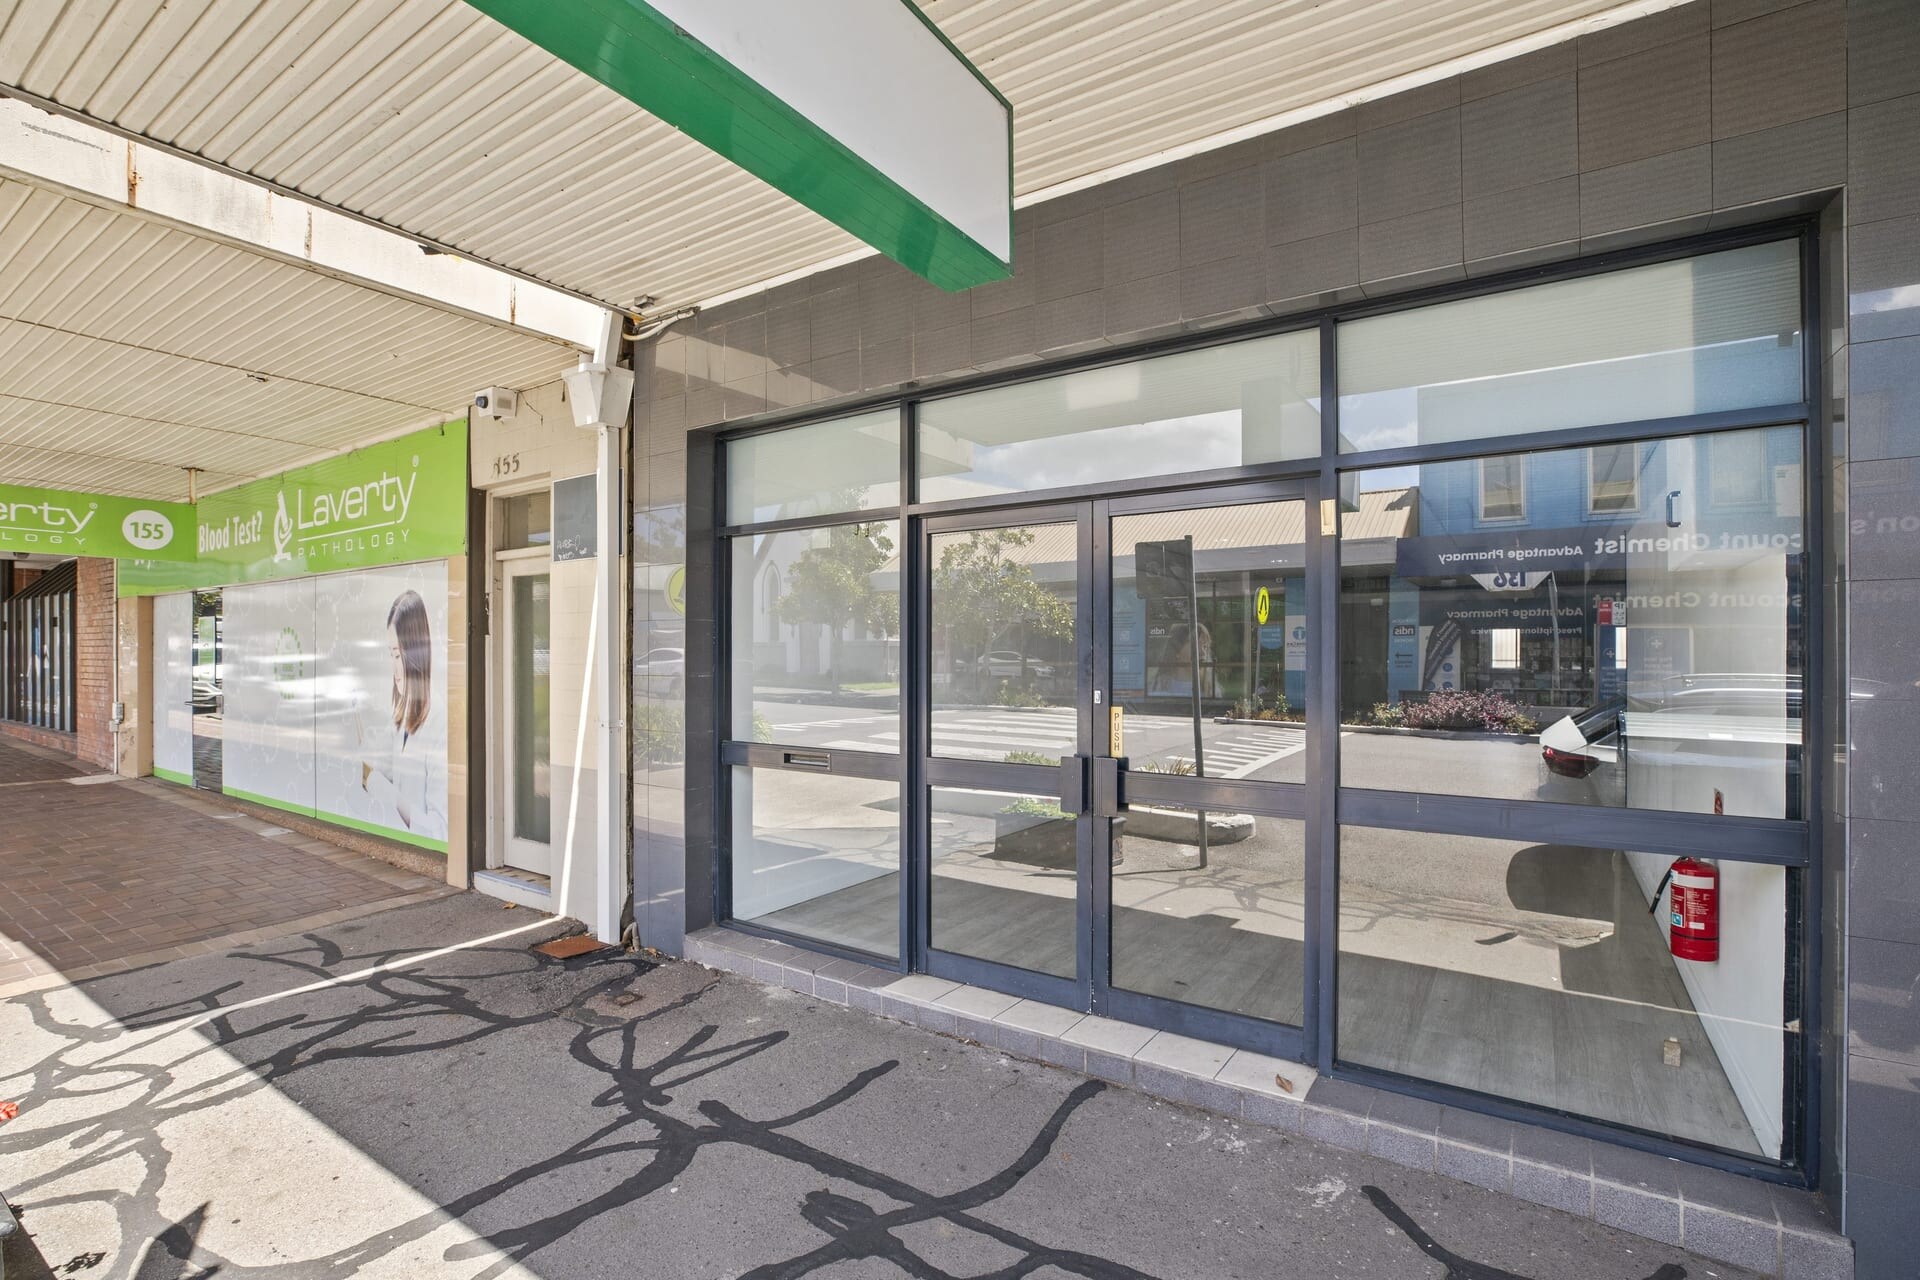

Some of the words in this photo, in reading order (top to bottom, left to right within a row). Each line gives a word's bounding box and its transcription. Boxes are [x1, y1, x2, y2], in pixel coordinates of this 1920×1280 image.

[298, 472, 416, 529] Laverty
[2, 532, 86, 545] LOGY
[130, 522, 164, 540] 155
[199, 517, 230, 553] Blood
[233, 510, 262, 546] Test?
[298, 529, 410, 557] PATHOLOGY
